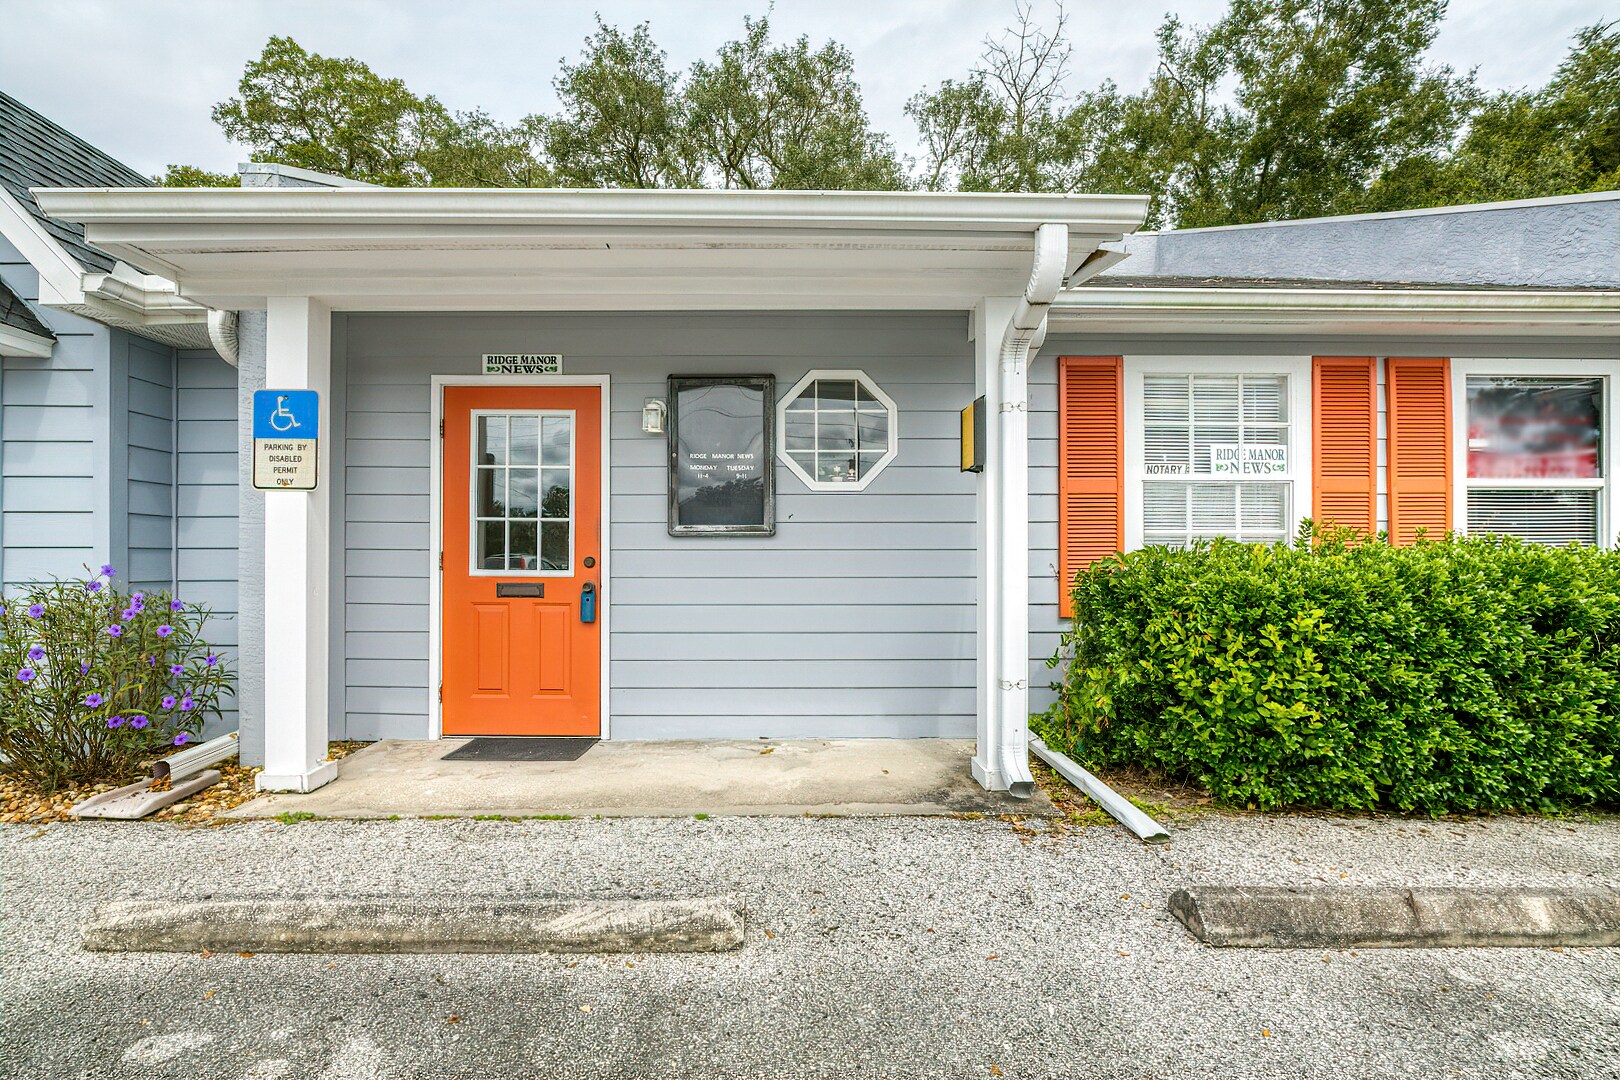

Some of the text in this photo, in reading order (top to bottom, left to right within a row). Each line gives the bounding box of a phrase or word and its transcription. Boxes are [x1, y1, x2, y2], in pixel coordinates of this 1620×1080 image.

[487, 355, 557, 364] RIDGE MANOR
[501, 365, 544, 373] NEWS
[1249, 449, 1285, 460] MANOR
[1146, 465, 1182, 474] NOTARY
[1230, 462, 1271, 474] NEWS
